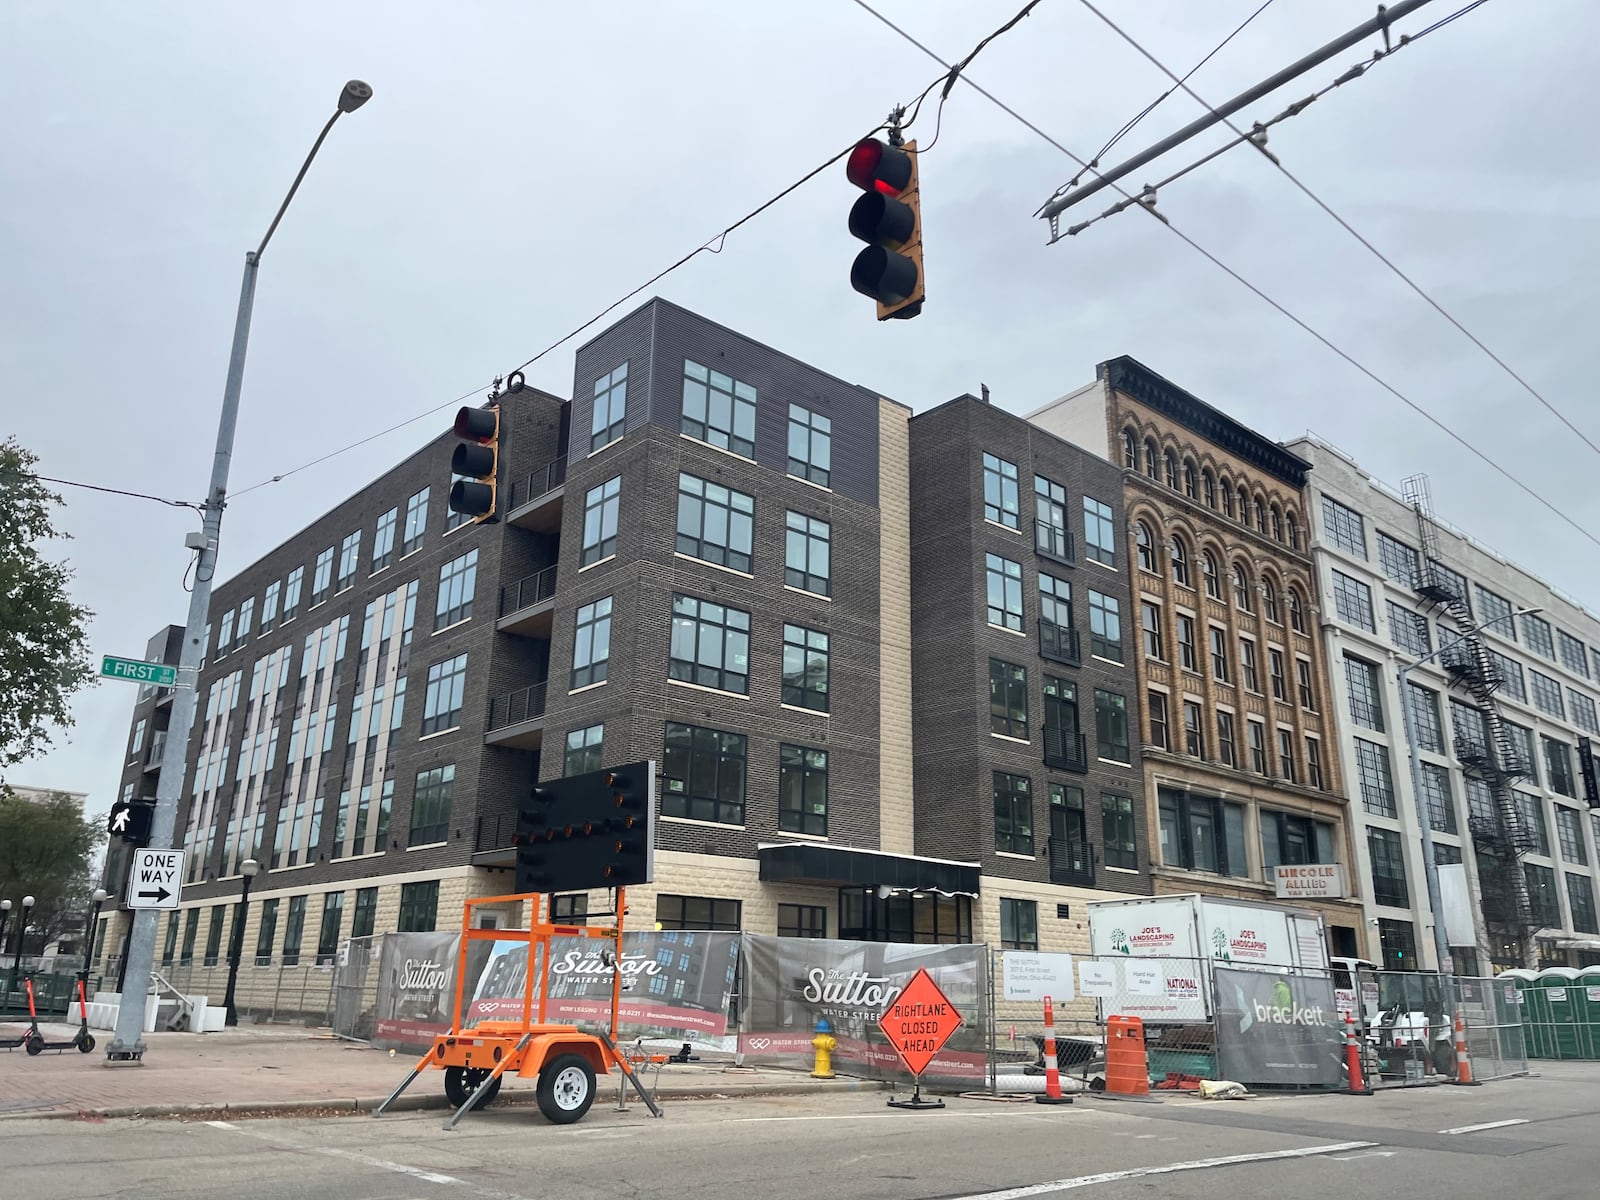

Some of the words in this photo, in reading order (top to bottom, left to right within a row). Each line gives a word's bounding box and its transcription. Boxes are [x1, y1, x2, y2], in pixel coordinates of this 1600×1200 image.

[105, 663, 109, 671] E
[114, 662, 155, 679] FIRST
[144, 855, 176, 867] ONE
[141, 870, 175, 883] WAY
[1278, 867, 1334, 878] LINCOLN
[1286, 880, 1327, 889] ALLIED
[1141, 926, 1161, 934] JOE'S
[1240, 930, 1256, 939] JOE'S
[1129, 933, 1175, 942] LANDSCAPING
[1230, 938, 1267, 950] LANDSCAPING
[400, 959, 447, 989] Sutton
[828, 969, 844, 980] The
[602, 977, 638, 985] STEET
[803, 967, 902, 1007] Sutton
[1167, 978, 1198, 989] NATIONAL
[821, 1008, 848, 1019] WATER
[852, 1011, 881, 1021] STREE
[1253, 998, 1326, 1026] brackett
[901, 1022, 938, 1035] CLOSED
[903, 1039, 935, 1052] AHEAD
